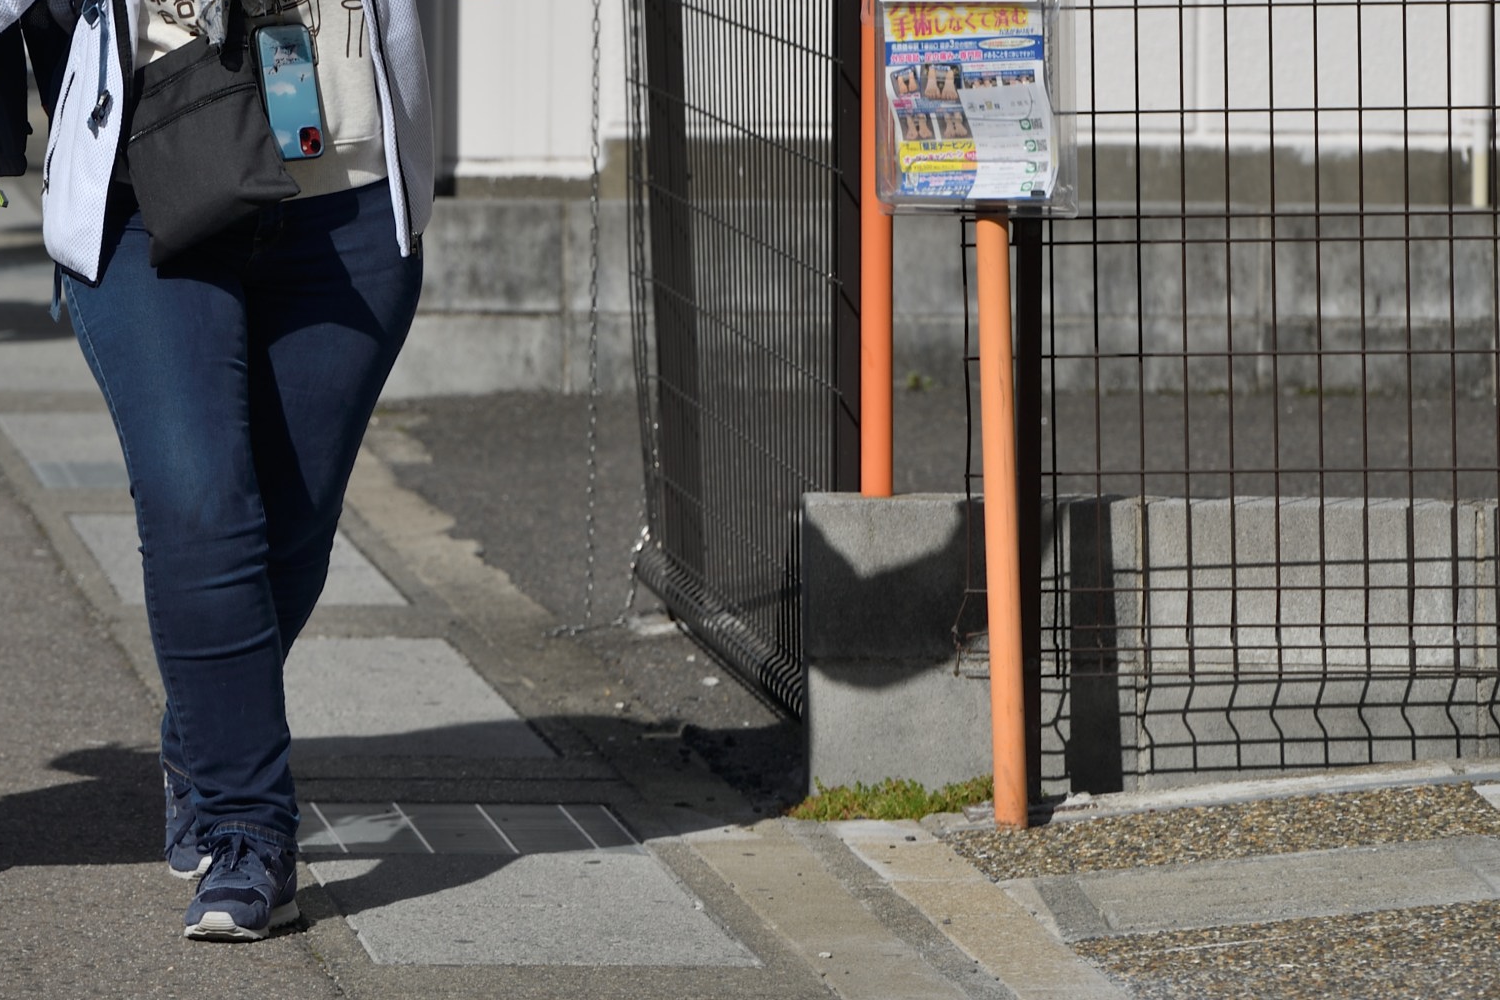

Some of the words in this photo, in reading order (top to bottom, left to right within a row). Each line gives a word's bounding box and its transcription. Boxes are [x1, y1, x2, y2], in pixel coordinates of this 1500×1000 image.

[893, 6, 1027, 38] 手術しなくて済む
